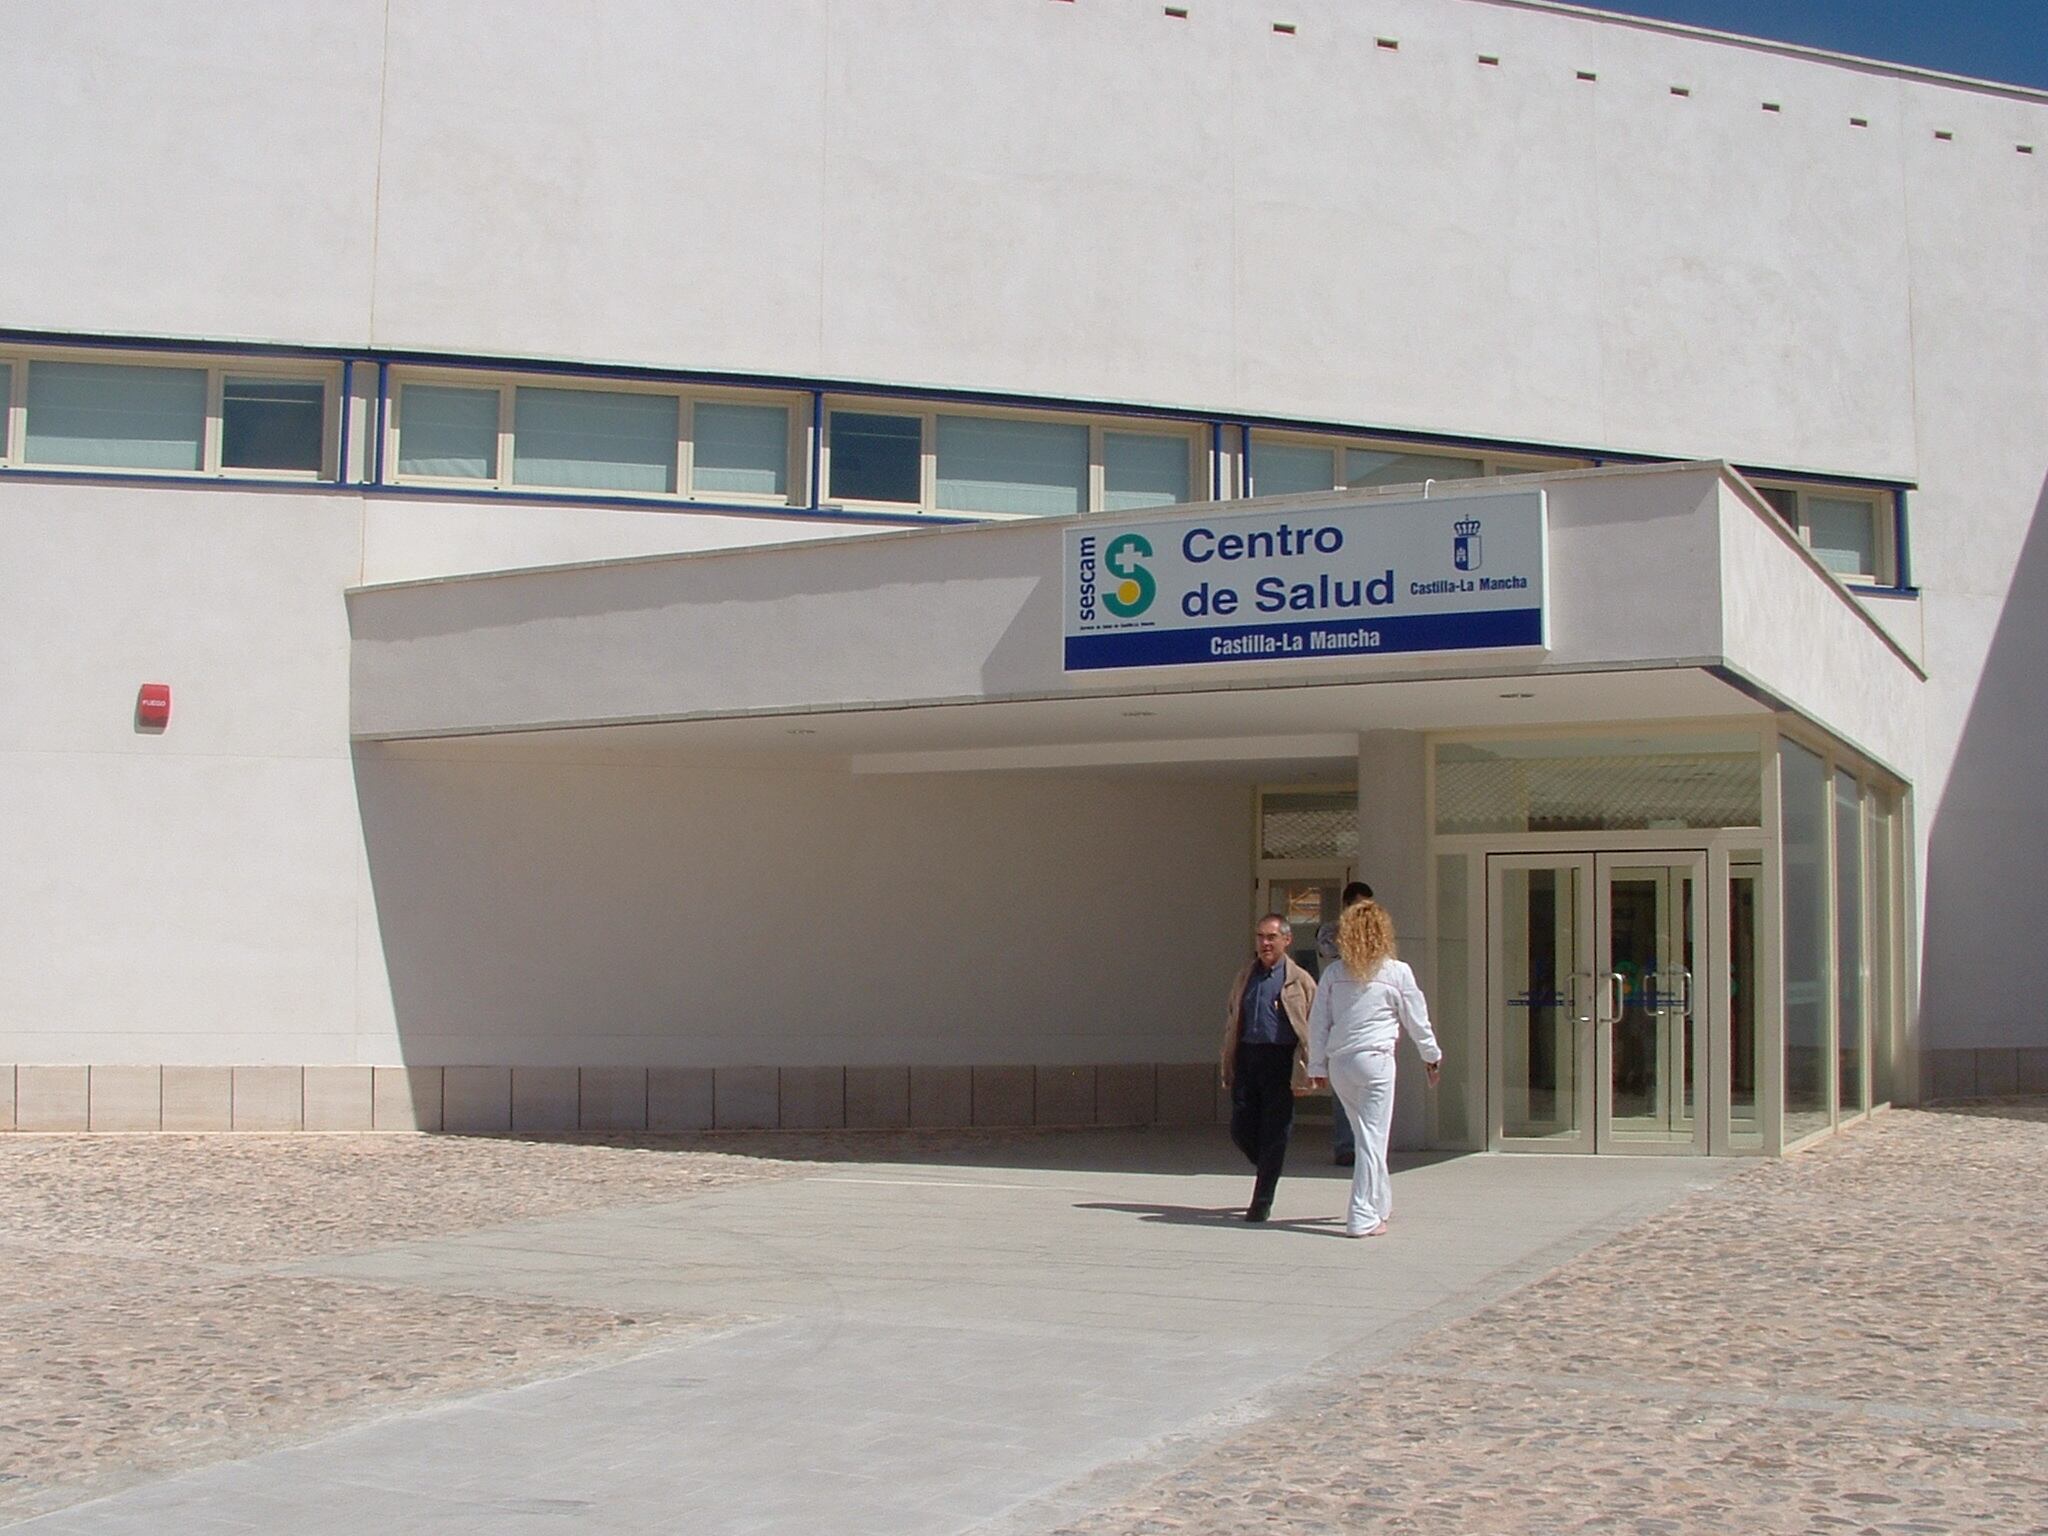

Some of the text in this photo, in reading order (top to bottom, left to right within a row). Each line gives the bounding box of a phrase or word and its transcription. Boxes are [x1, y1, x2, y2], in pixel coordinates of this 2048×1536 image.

[1182, 523, 1343, 563] Centro
[1080, 536, 1096, 621] sescam
[1181, 569, 1395, 617] de Salud
[1410, 576, 1527, 595] Castilla-La Mancha
[1211, 628, 1380, 655] Castilla-La Mancha
